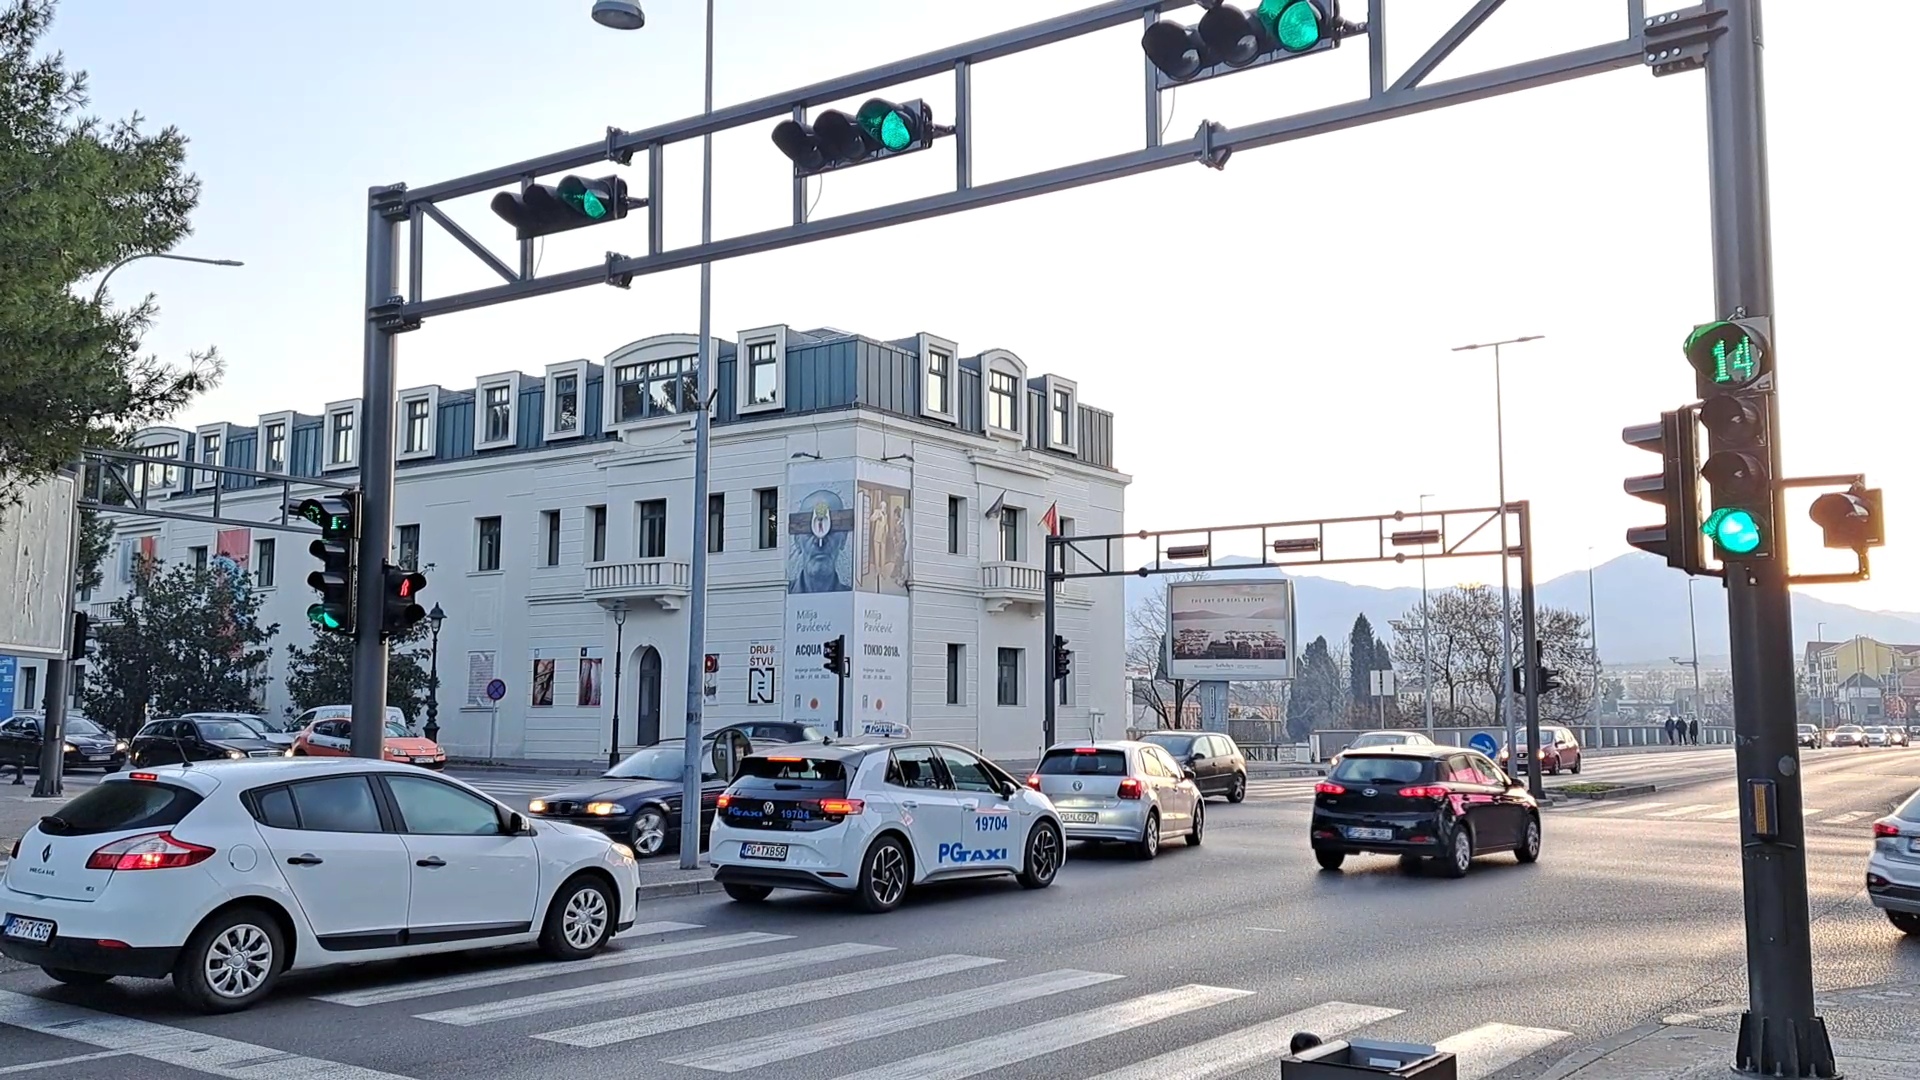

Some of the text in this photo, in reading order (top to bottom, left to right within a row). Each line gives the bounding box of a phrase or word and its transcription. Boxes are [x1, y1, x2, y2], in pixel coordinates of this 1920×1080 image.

[1713, 335, 1753, 382] 14
[795, 644, 822, 657] ACQUA
[863, 643, 883, 656] TOKIO
[781, 809, 811, 819] 19704
[975, 815, 1008, 832] 19704
